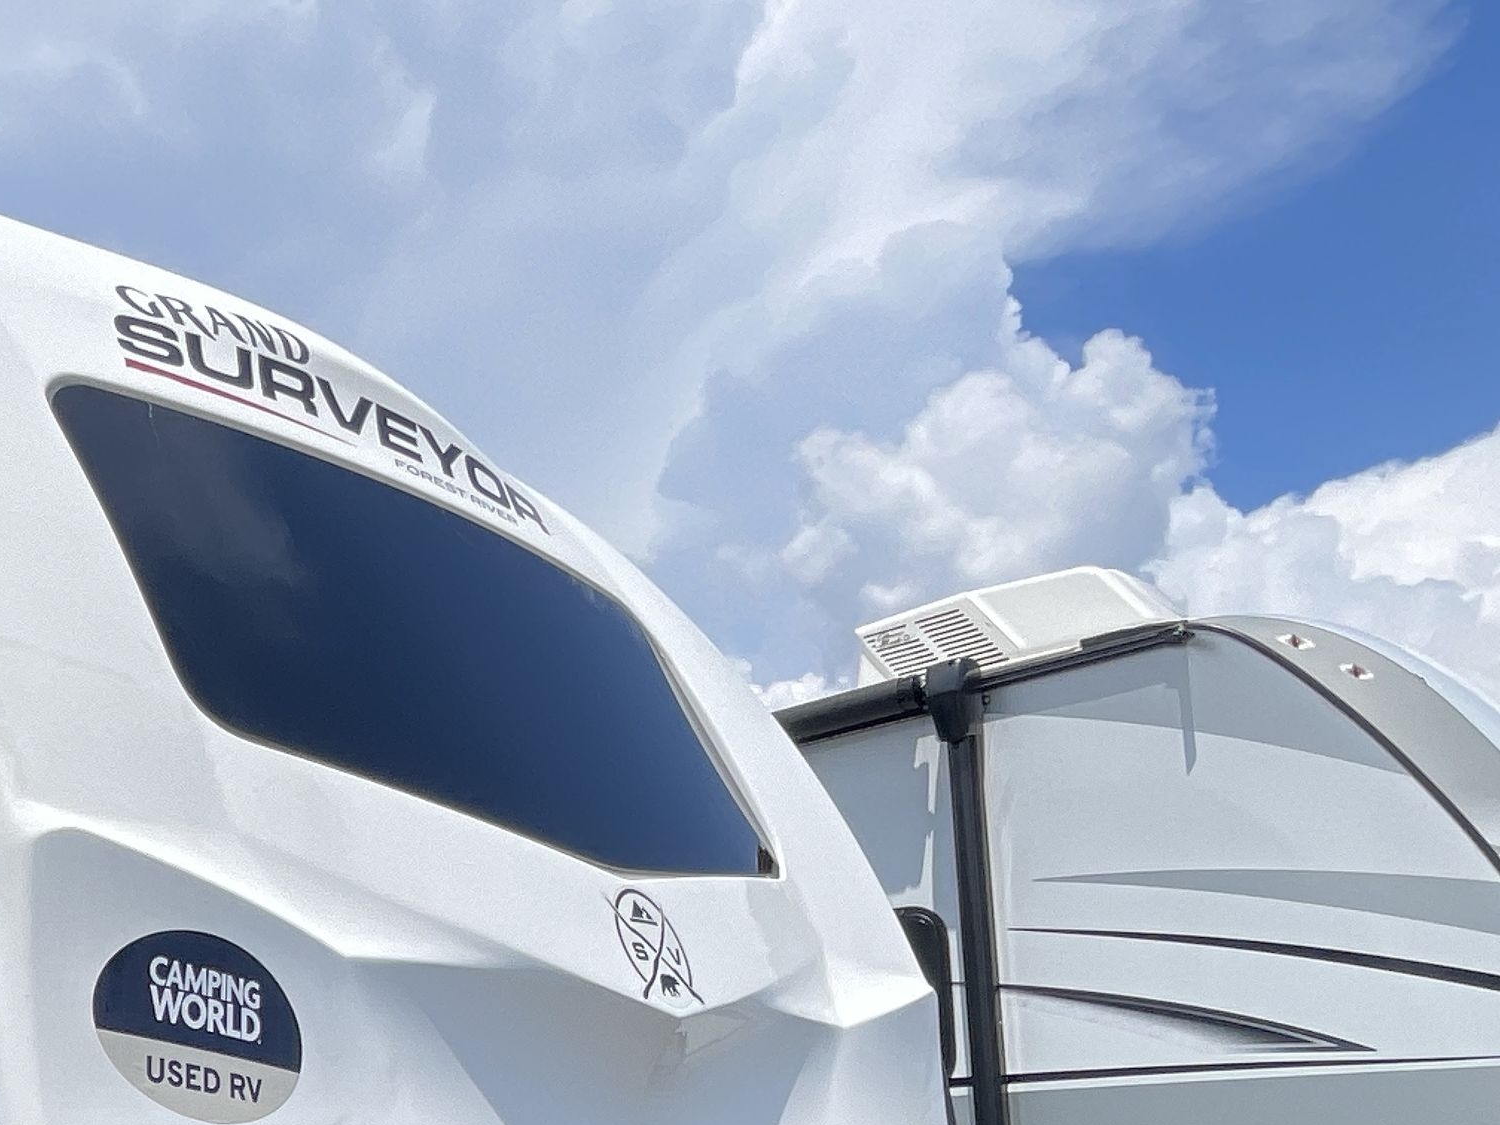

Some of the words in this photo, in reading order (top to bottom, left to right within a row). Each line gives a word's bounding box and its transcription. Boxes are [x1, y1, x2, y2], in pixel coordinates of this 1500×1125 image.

[115, 284, 310, 365] GRAND
[113, 314, 551, 536] SURVEYOR
[394, 458, 466, 498] FOREST
[470, 494, 519, 526] RIVER
[632, 942, 649, 961] S
[666, 946, 681, 965] V
[149, 956, 261, 1010] CAMPING
[149, 984, 261, 1042] WORLD
[146, 1055, 220, 1094] USED
[230, 1072, 262, 1103] RV
